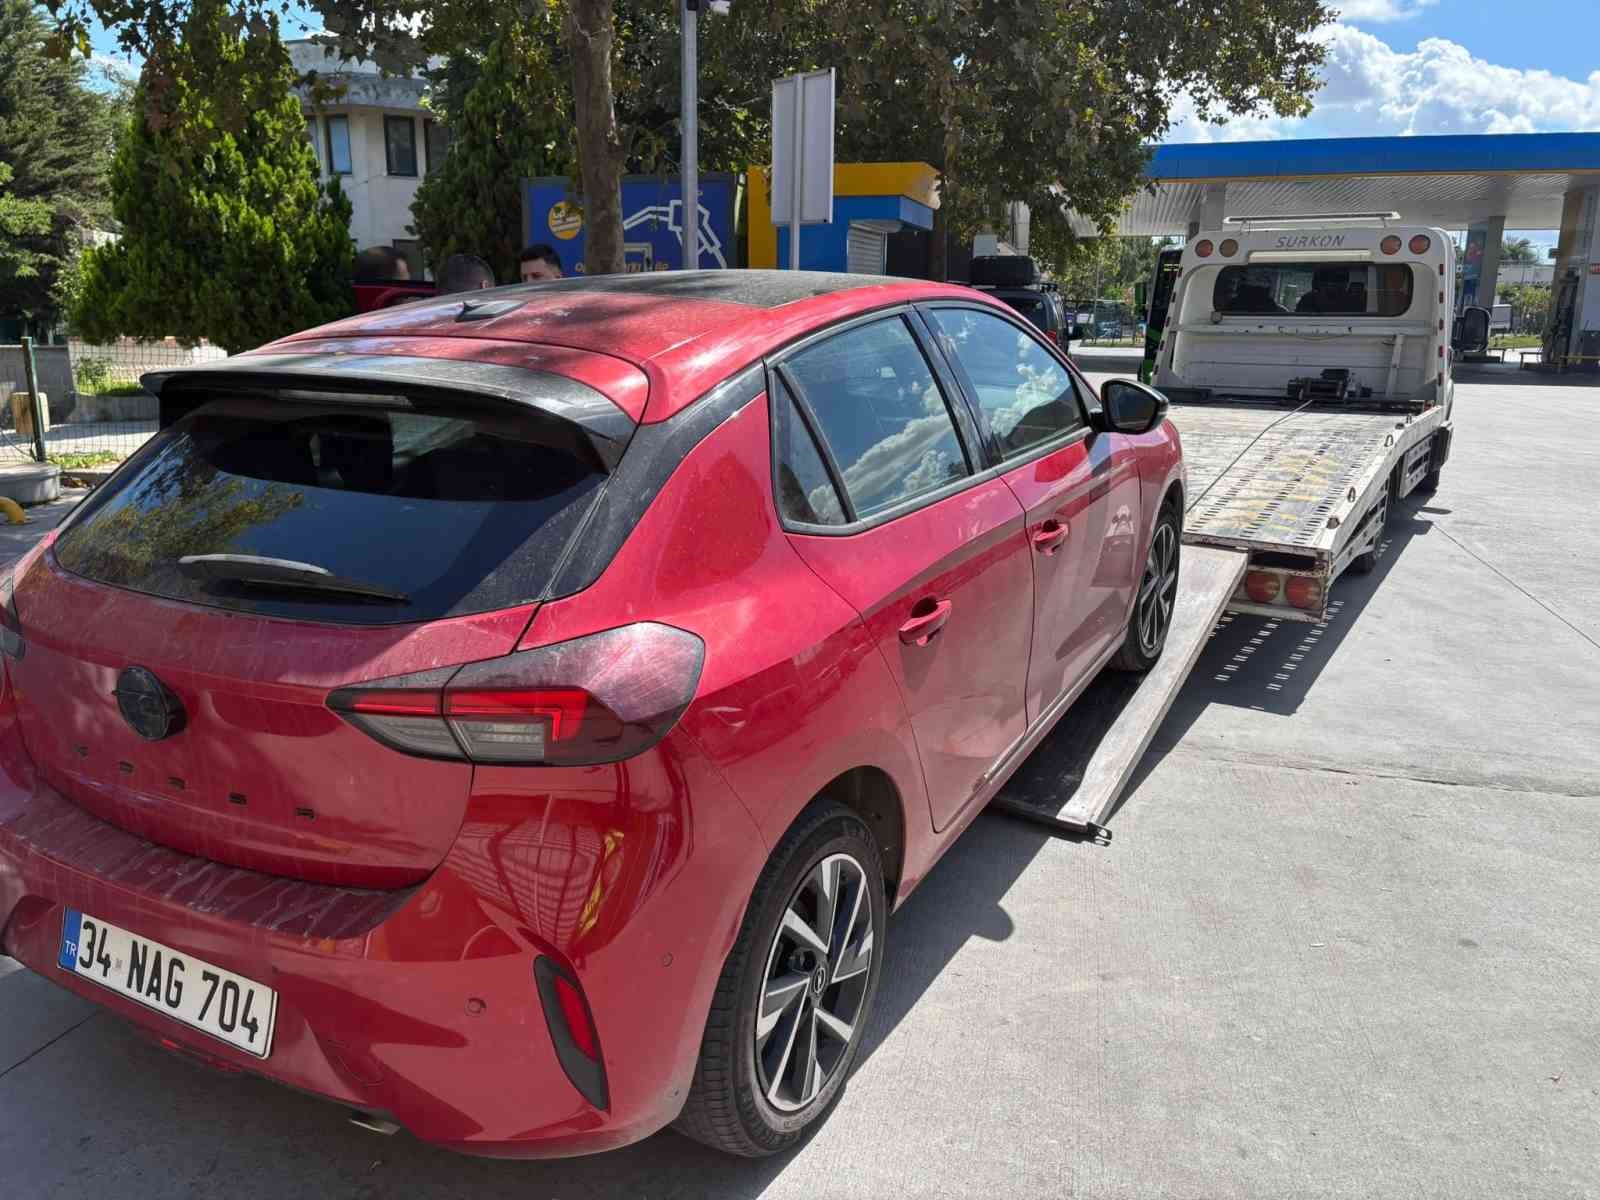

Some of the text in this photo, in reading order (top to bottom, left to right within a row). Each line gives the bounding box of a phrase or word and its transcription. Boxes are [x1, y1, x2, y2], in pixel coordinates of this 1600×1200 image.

[65, 940, 77, 957] TR
[79, 920, 260, 1043] 34 NAG 704
